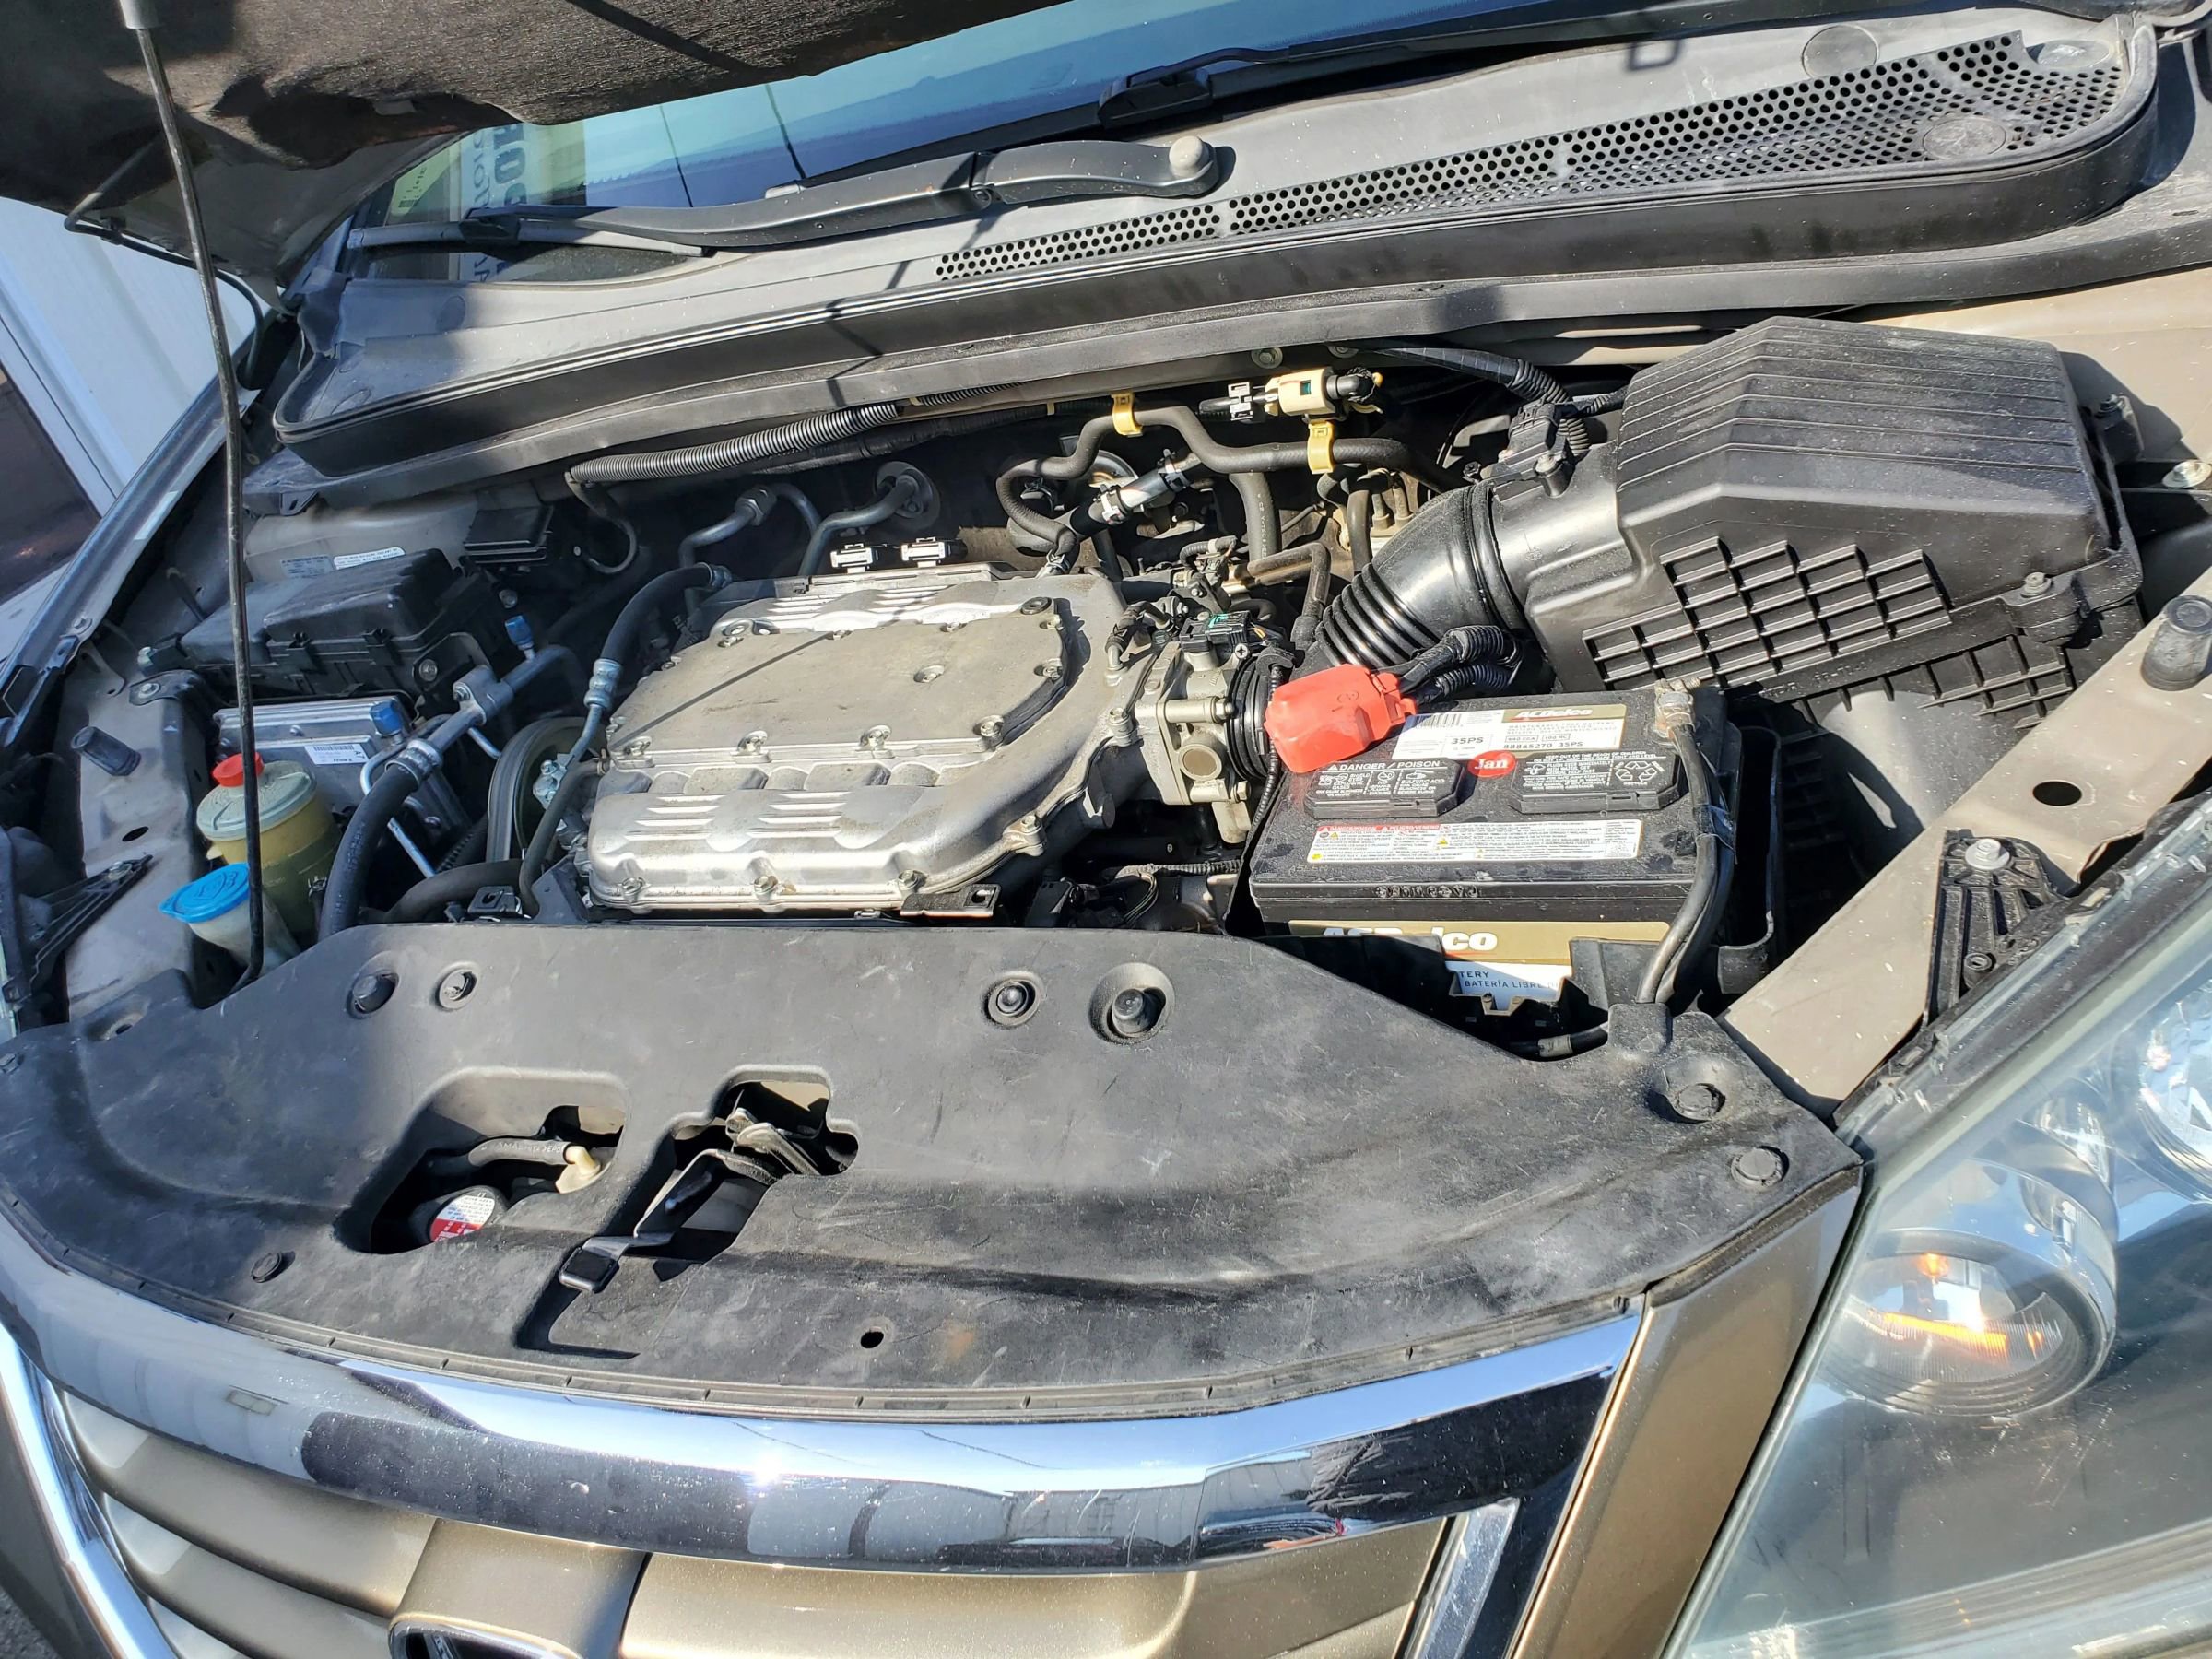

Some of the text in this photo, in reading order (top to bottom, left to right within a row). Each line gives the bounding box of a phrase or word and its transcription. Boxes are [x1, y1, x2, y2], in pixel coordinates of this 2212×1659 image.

[1514, 709, 1593, 718] ACDelco
[1339, 762, 1386, 771] DANGER
[1397, 760, 1441, 769] POISON
[1475, 758, 1509, 770] Jan
[1465, 979, 1509, 988] BATERÍA
